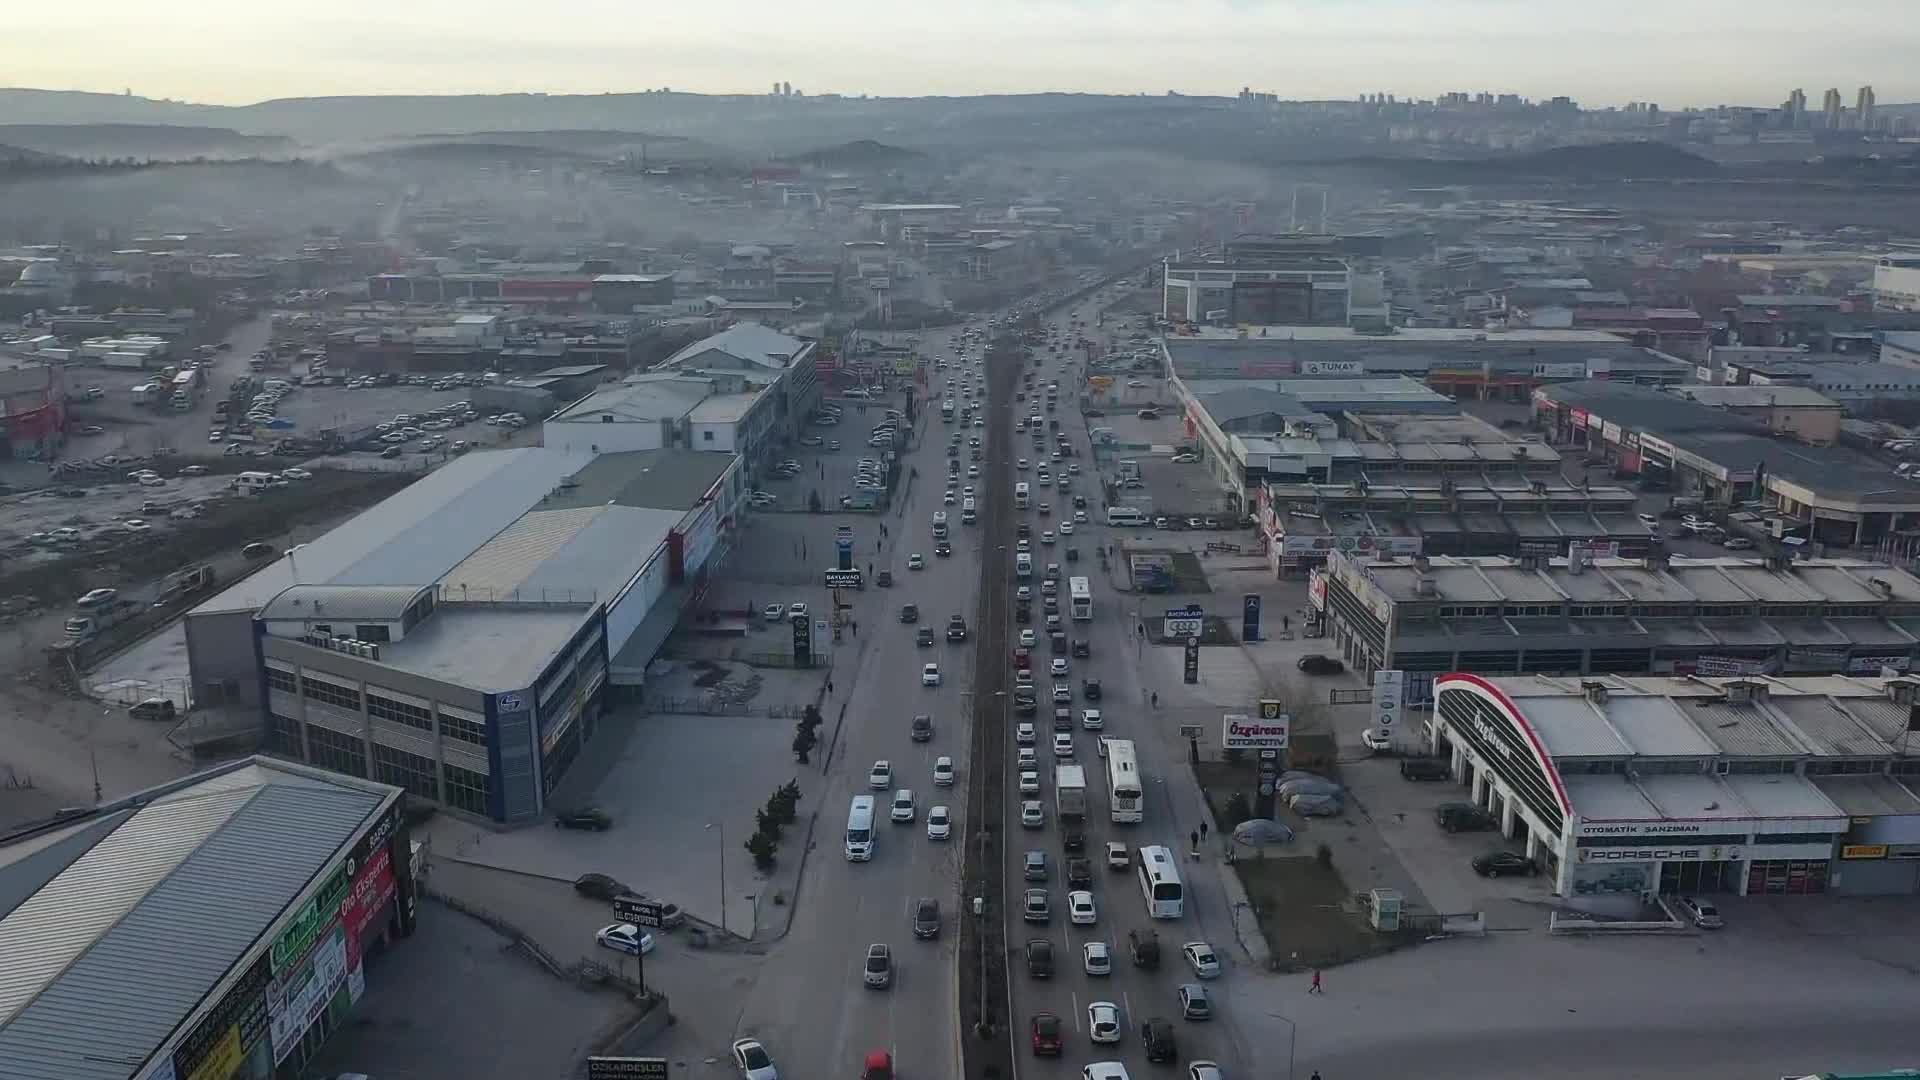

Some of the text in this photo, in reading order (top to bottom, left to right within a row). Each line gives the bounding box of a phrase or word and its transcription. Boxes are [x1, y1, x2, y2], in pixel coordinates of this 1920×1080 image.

[1320, 362, 1355, 370] TUNAY
[1230, 721, 1284, 738] Özgürcan
[1474, 710, 1510, 760] Özgürcan
[1591, 850, 1700, 860] PORSCHE
[341, 893, 357, 917] Oto
